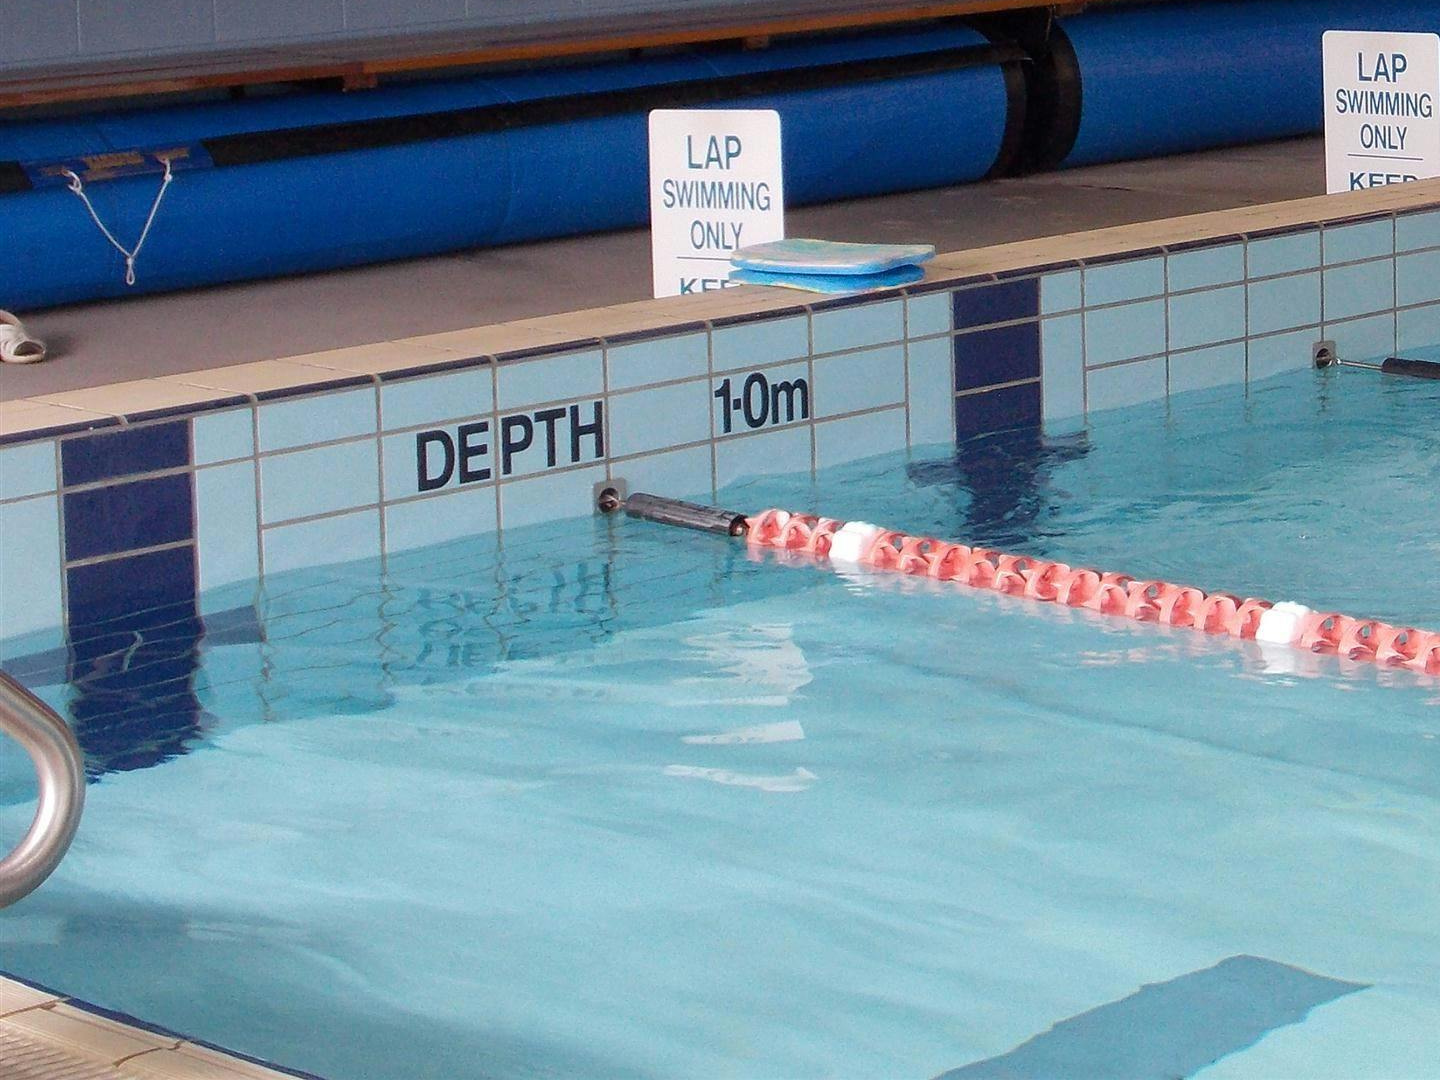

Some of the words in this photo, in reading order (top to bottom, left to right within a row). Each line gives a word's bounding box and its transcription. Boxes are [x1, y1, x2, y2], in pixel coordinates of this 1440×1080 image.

[1358, 52, 1408, 83] LAP
[1336, 88, 1433, 118] SWIMMING
[686, 134, 743, 170] LAP
[1360, 123, 1408, 150] ONLY
[662, 178, 771, 211] SWIMMING
[690, 219, 744, 250] ONLY
[416, 400, 604, 493] DEPTH
